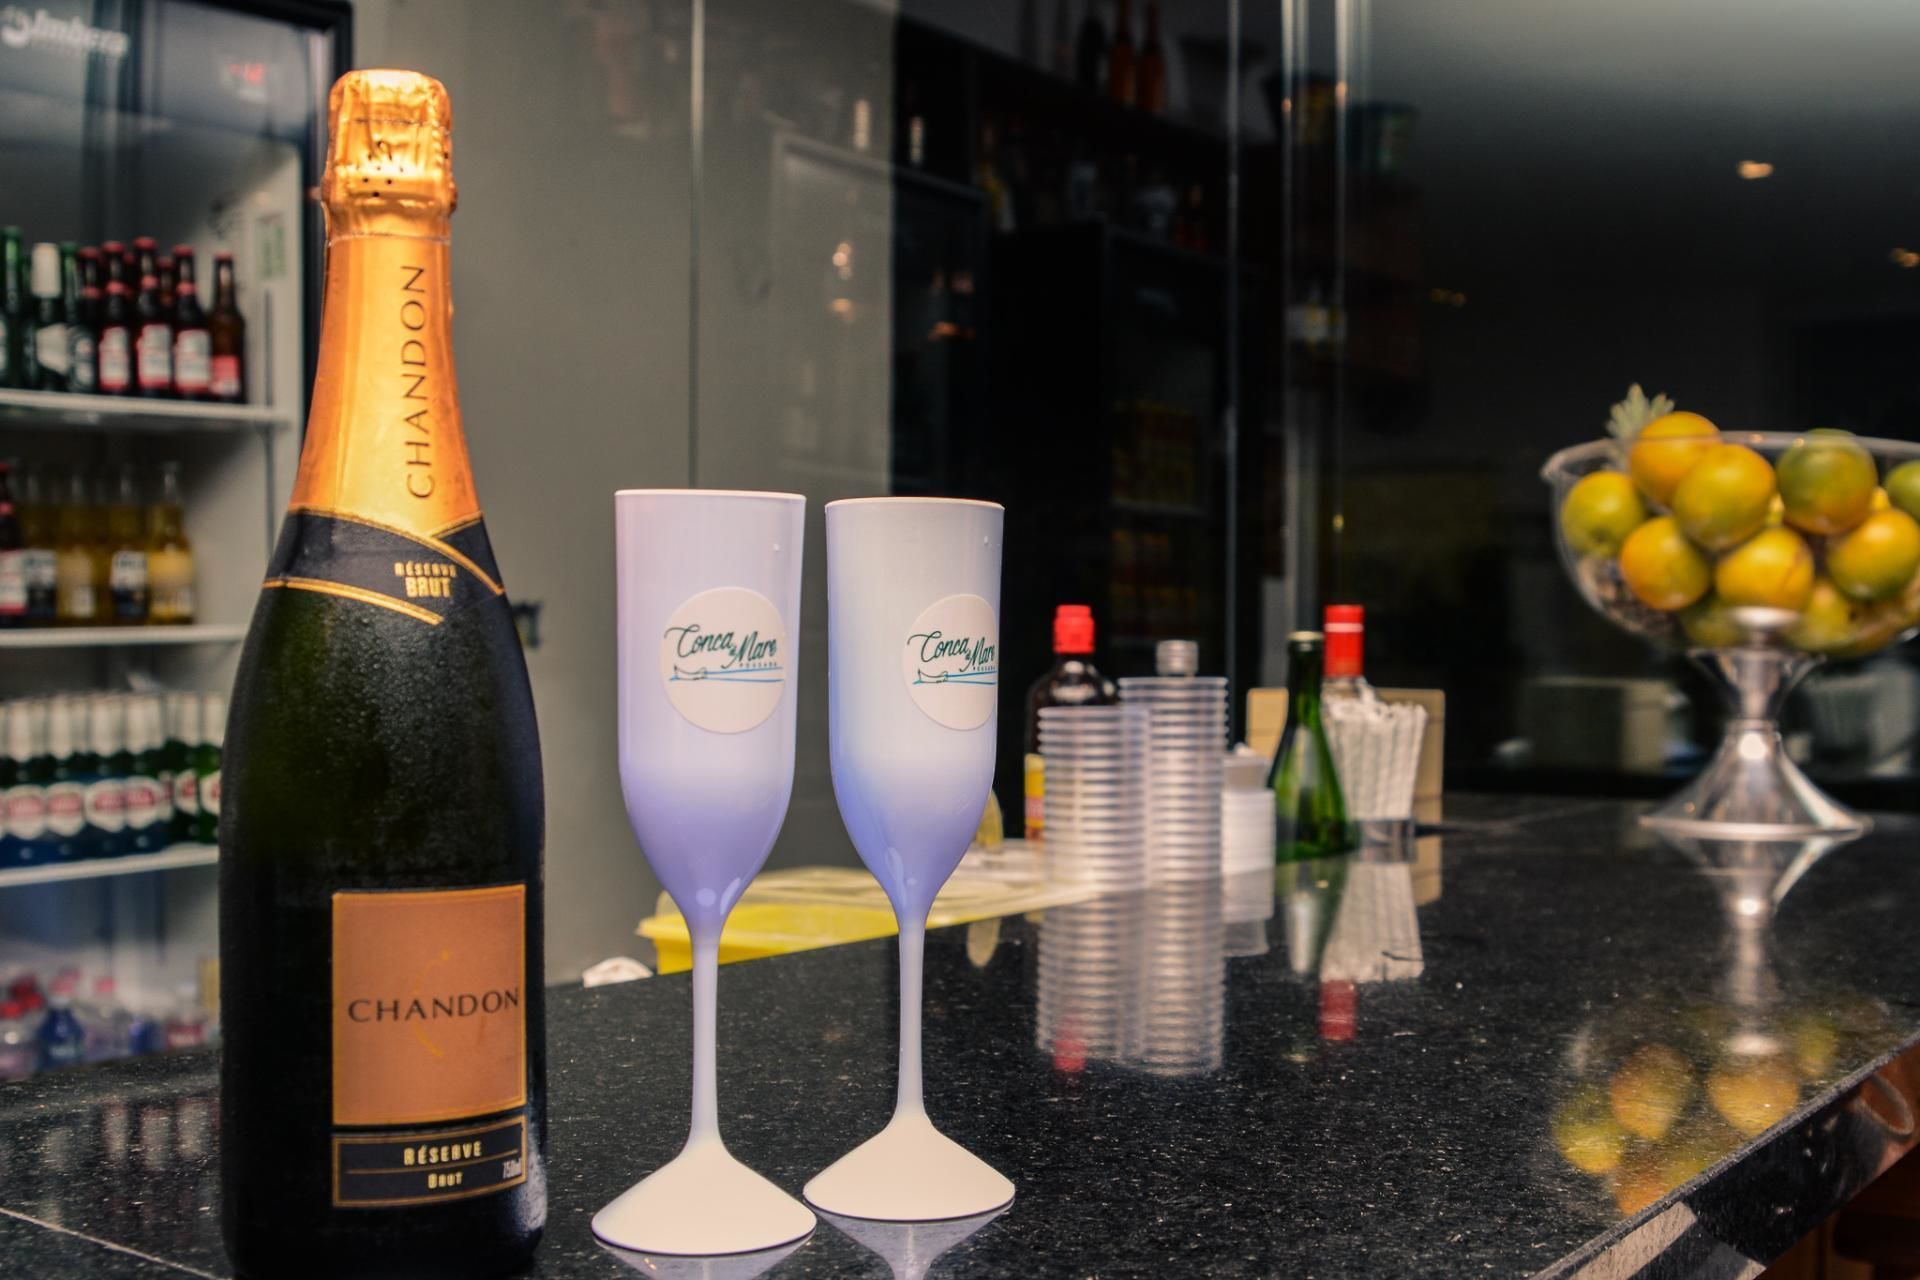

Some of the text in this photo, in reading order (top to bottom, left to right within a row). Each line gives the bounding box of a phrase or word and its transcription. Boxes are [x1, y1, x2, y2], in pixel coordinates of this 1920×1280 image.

[400, 265, 435, 499] CHANDON
[405, 577, 450, 598] BRUT
[663, 623, 734, 658] Conca
[906, 630, 970, 663] Conca
[347, 987, 519, 1022] CHANDON
[403, 1141, 482, 1166] RÉSERVE
